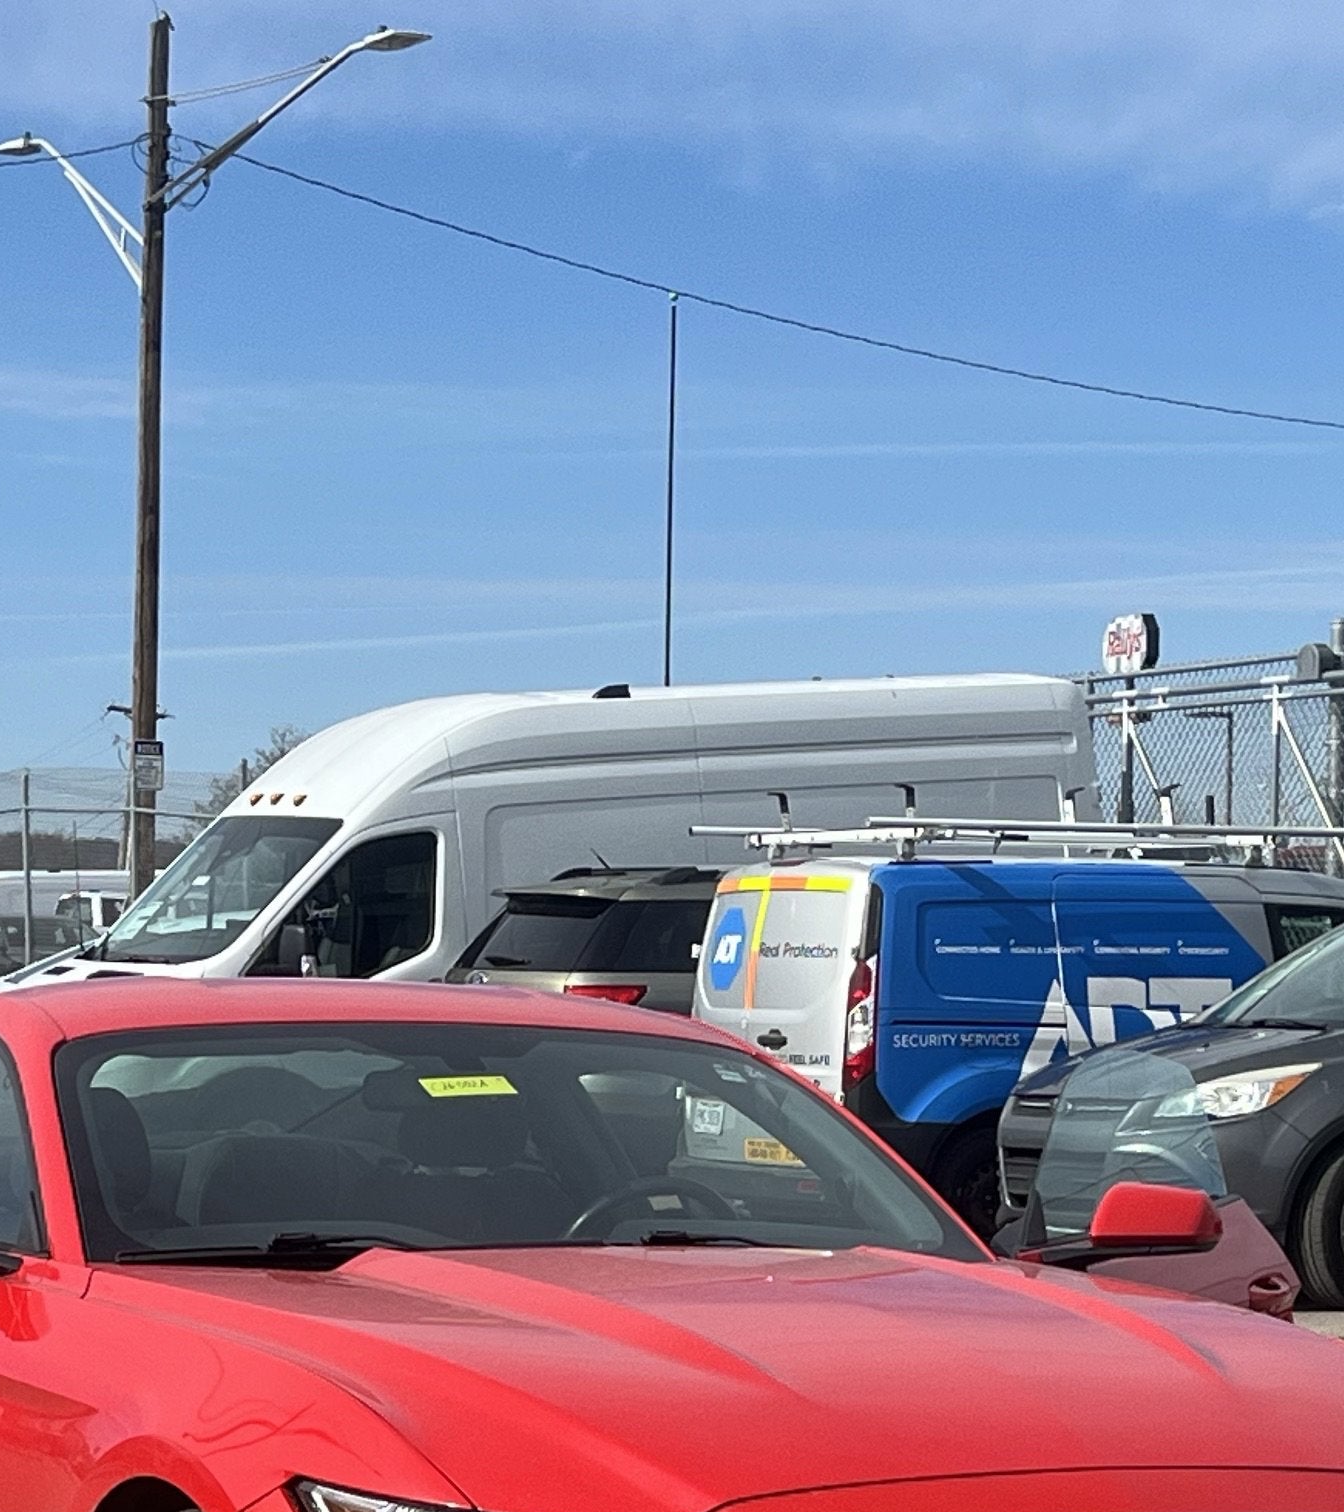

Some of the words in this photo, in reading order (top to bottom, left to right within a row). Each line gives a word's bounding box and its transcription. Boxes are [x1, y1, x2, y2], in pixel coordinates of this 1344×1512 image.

[759, 941, 781, 958] Real
[783, 941, 838, 958] Protection
[893, 1034, 957, 1048] SECURITY
[960, 1033, 1020, 1047] SERVICES
